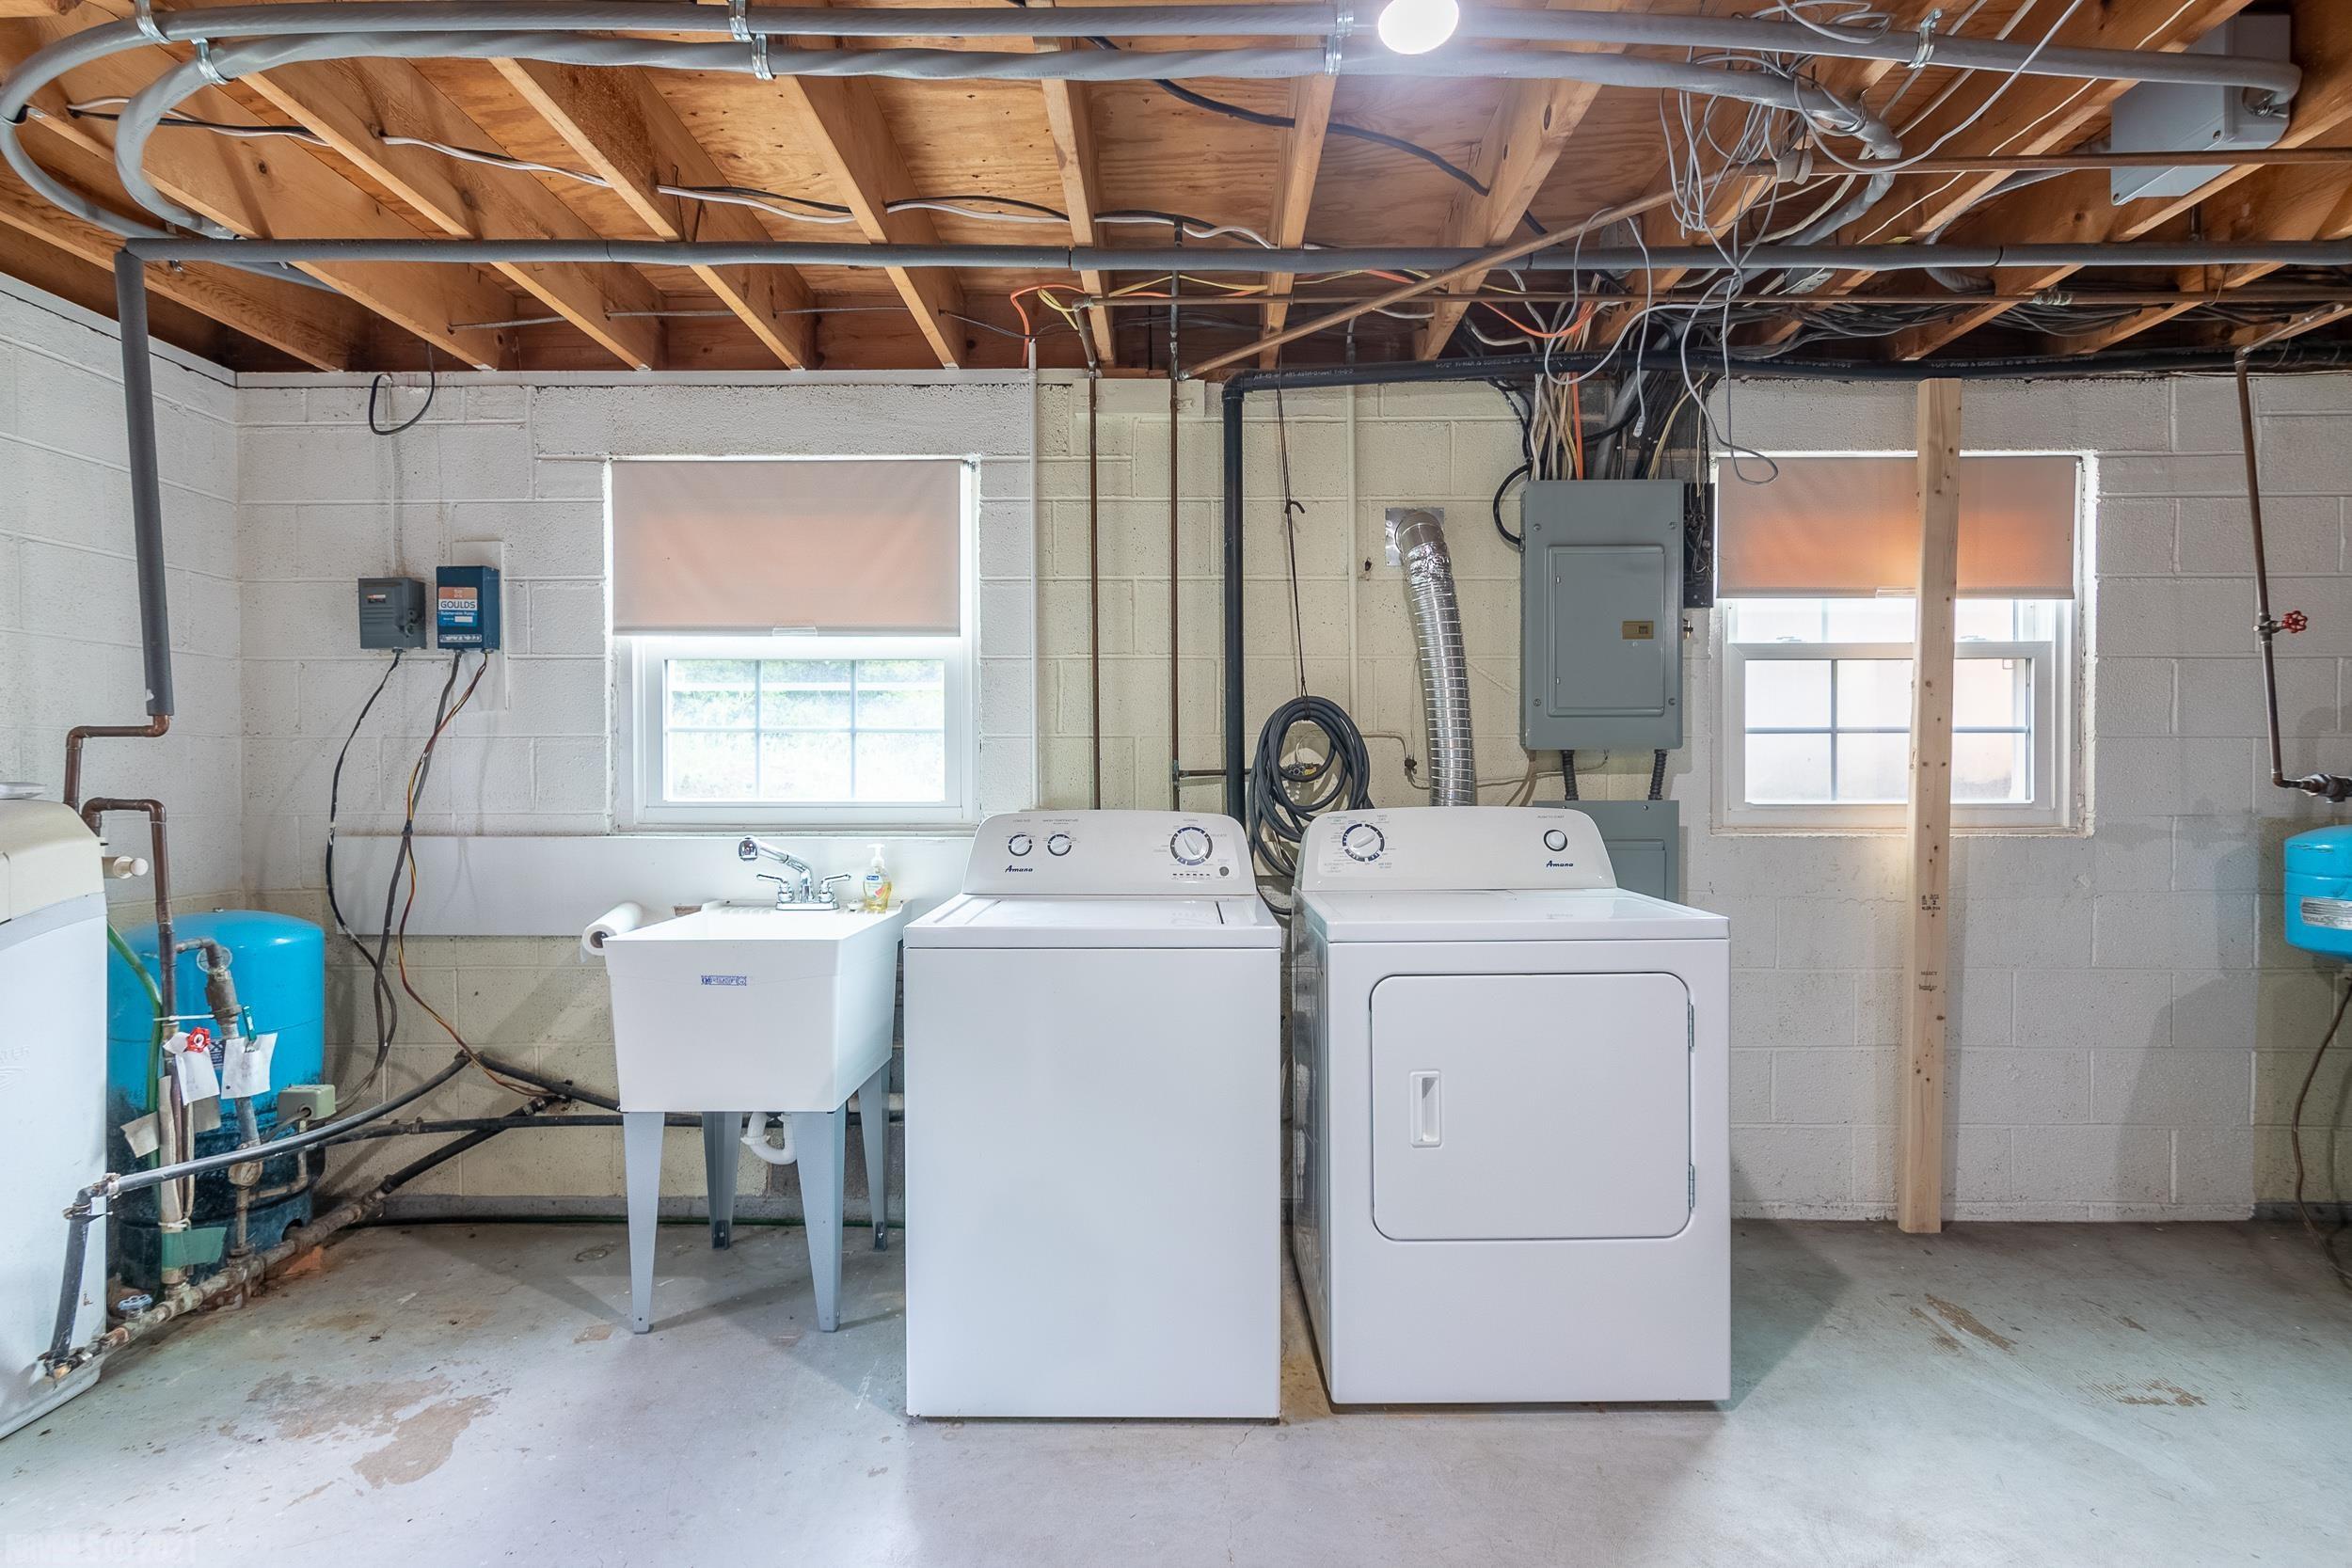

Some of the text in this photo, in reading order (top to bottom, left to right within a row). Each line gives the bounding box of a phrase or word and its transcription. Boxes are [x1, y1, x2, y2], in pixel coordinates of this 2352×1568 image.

[440, 600, 475, 609] GOULDS
[1005, 864, 1033, 873] Amana
[1546, 860, 1574, 868] Amana
